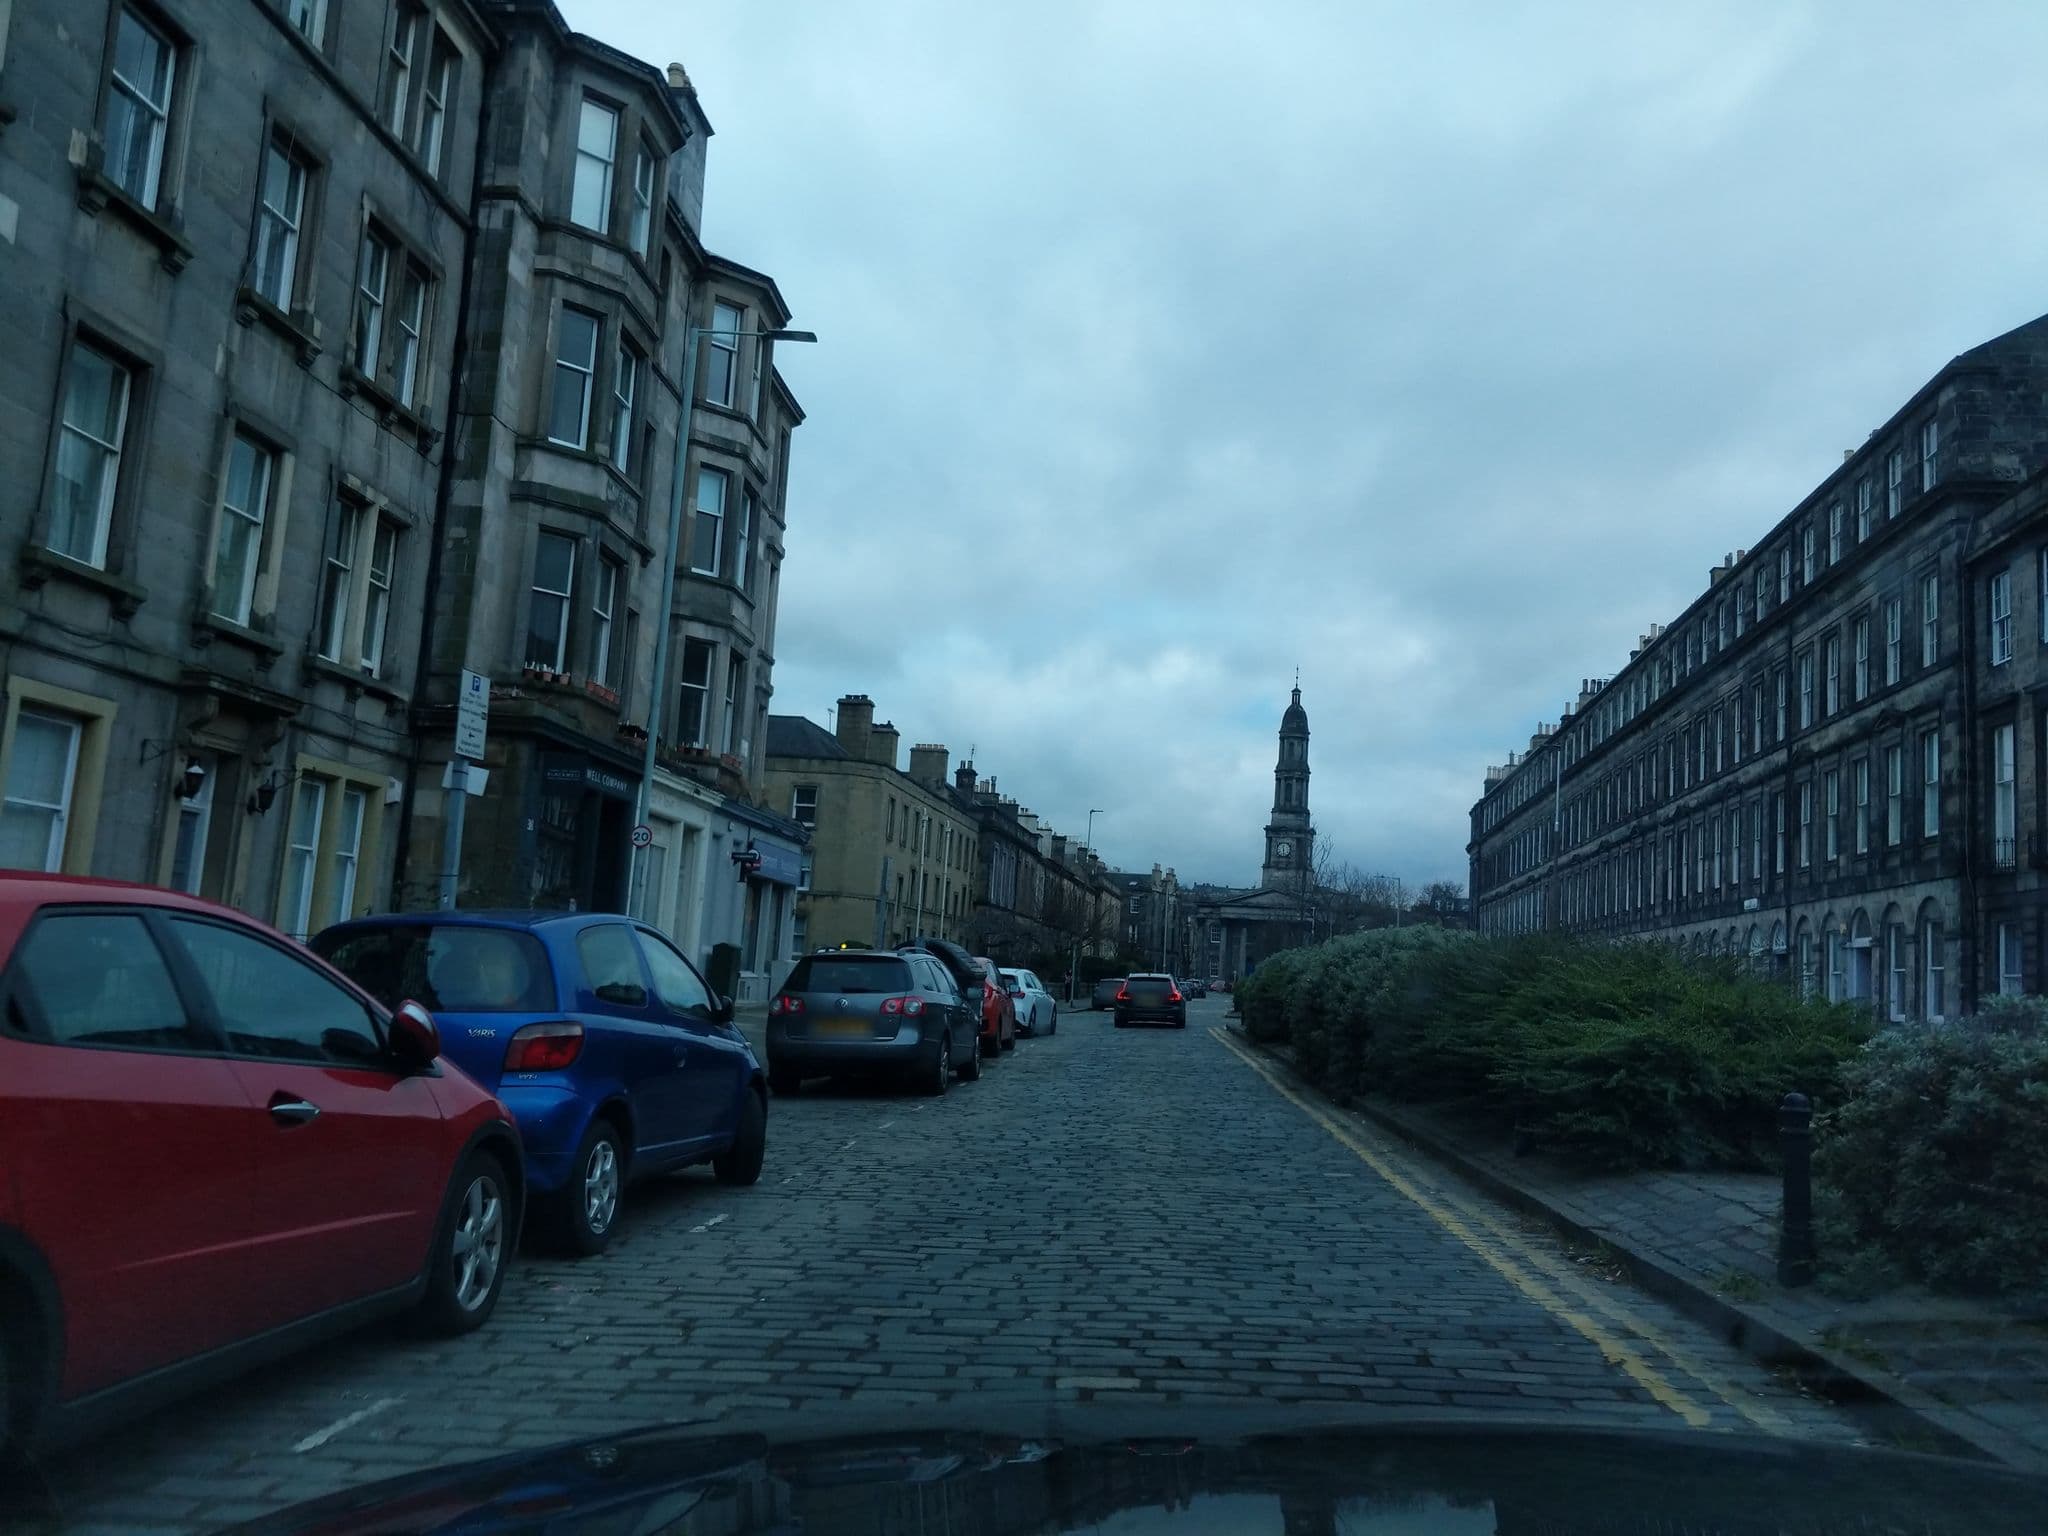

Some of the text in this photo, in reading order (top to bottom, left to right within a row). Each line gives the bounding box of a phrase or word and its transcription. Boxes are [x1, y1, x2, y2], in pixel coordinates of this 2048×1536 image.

[602, 774, 628, 792] COMPANY
[633, 831, 649, 841] 20
[468, 1028, 496, 1038] YARIS
